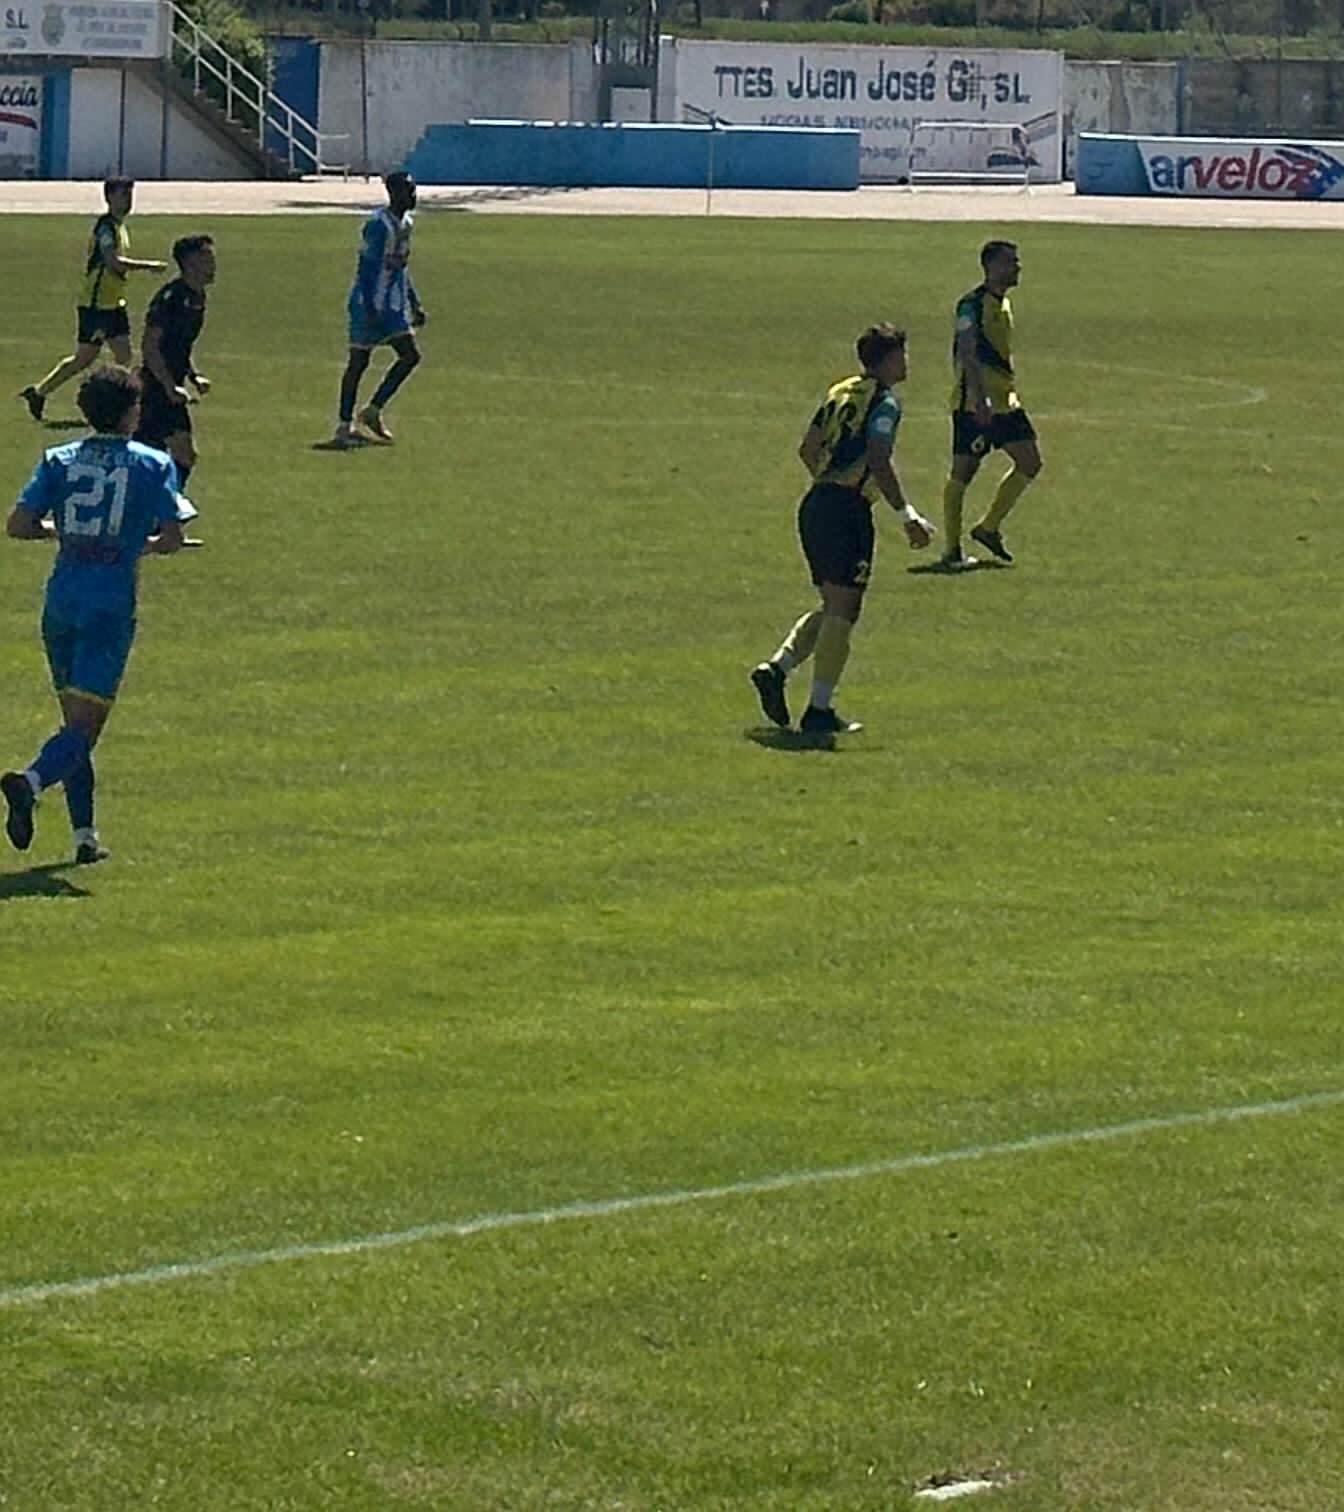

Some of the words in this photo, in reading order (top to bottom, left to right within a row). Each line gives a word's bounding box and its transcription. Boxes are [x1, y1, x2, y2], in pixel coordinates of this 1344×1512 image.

[787, 56, 855, 100] Juan
[868, 58, 936, 102] José
[63, 462, 130, 537] 21
